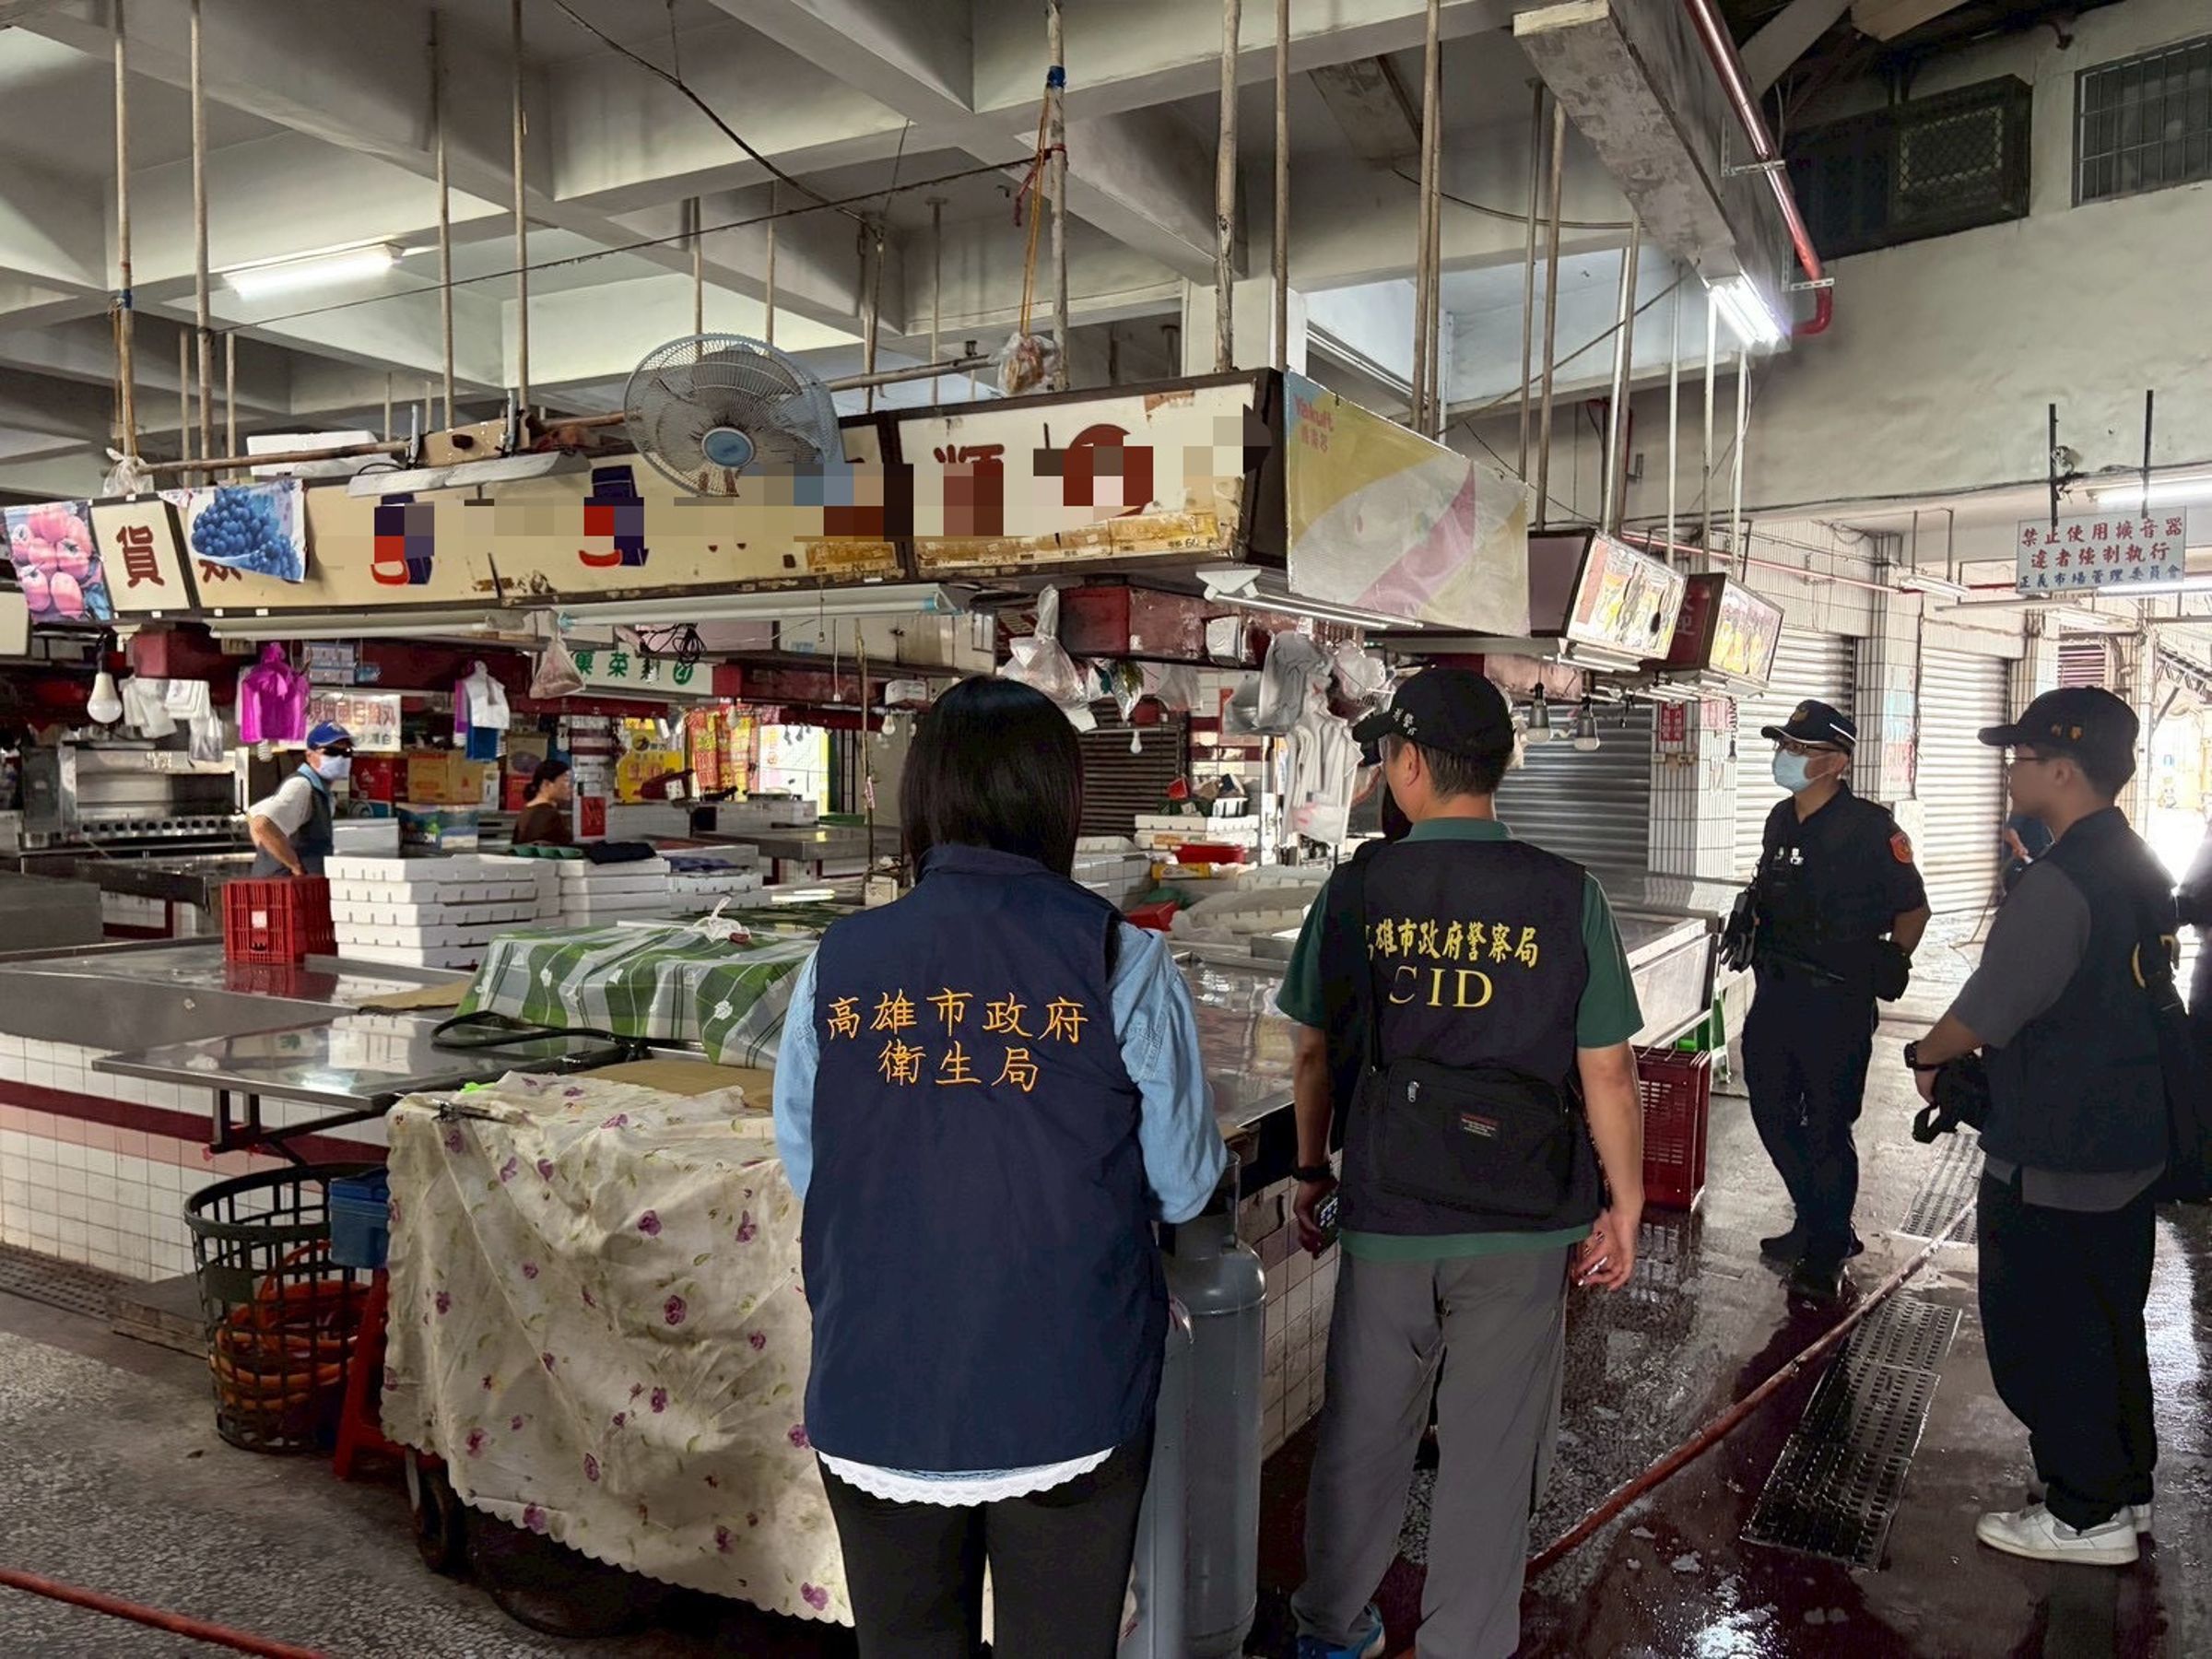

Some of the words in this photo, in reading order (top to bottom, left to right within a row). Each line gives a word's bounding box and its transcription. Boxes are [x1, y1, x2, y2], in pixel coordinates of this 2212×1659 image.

[1293, 394, 1335, 431] Yakult
[2022, 516, 2183, 547] 禁止使用擴音器
[116, 525, 165, 588] 貨
[2019, 564, 2182, 589] 正義市場管理委員會
[2031, 542, 2171, 570] 違者強制執行
[1365, 918, 1538, 968] 雄市政府警察局
[1389, 965, 1493, 1007] CID
[828, 987, 1088, 1044] 高雄市政府
[877, 1040, 1039, 1093] 衛生局
